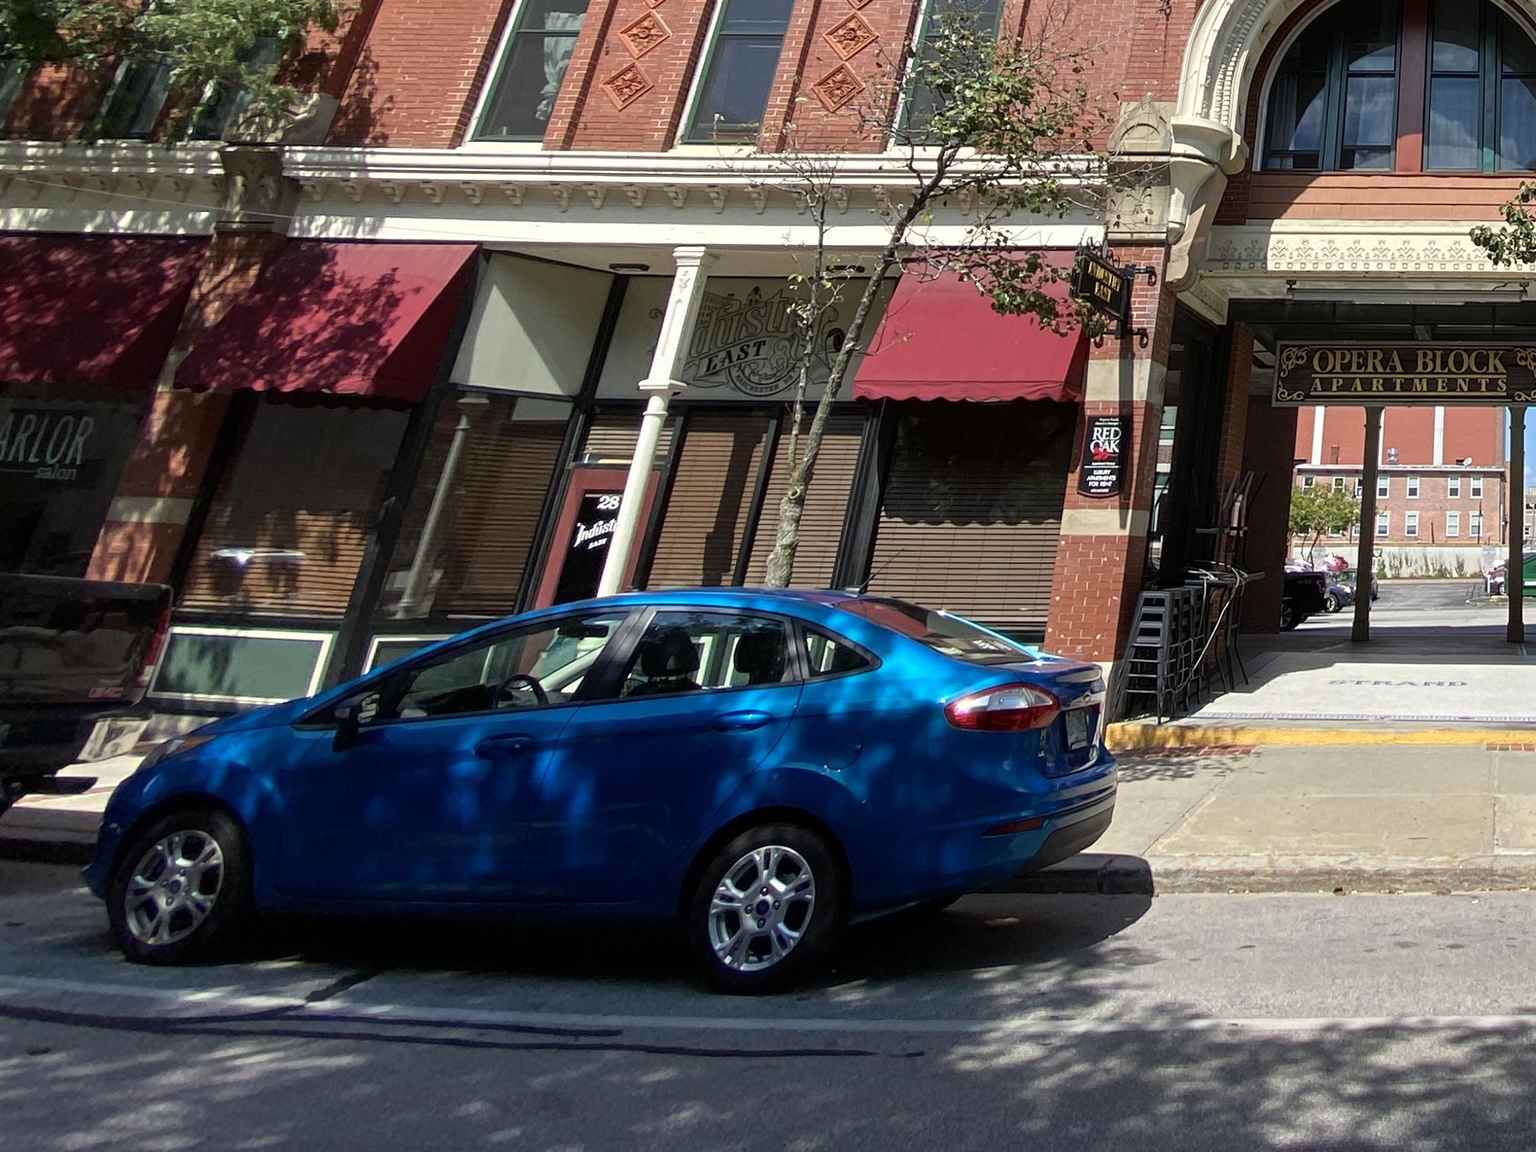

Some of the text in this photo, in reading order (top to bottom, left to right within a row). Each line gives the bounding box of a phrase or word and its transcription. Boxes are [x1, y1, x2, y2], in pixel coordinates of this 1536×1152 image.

[706, 339, 767, 374] EAST
[1311, 349, 1507, 374] OPERA BLOCK
[1310, 377, 1507, 392] APARTMENTS
[1092, 427, 1121, 441] RED
[1090, 439, 1119, 454] OAK
[34, 464, 77, 480] salon
[597, 495, 619, 509] 28
